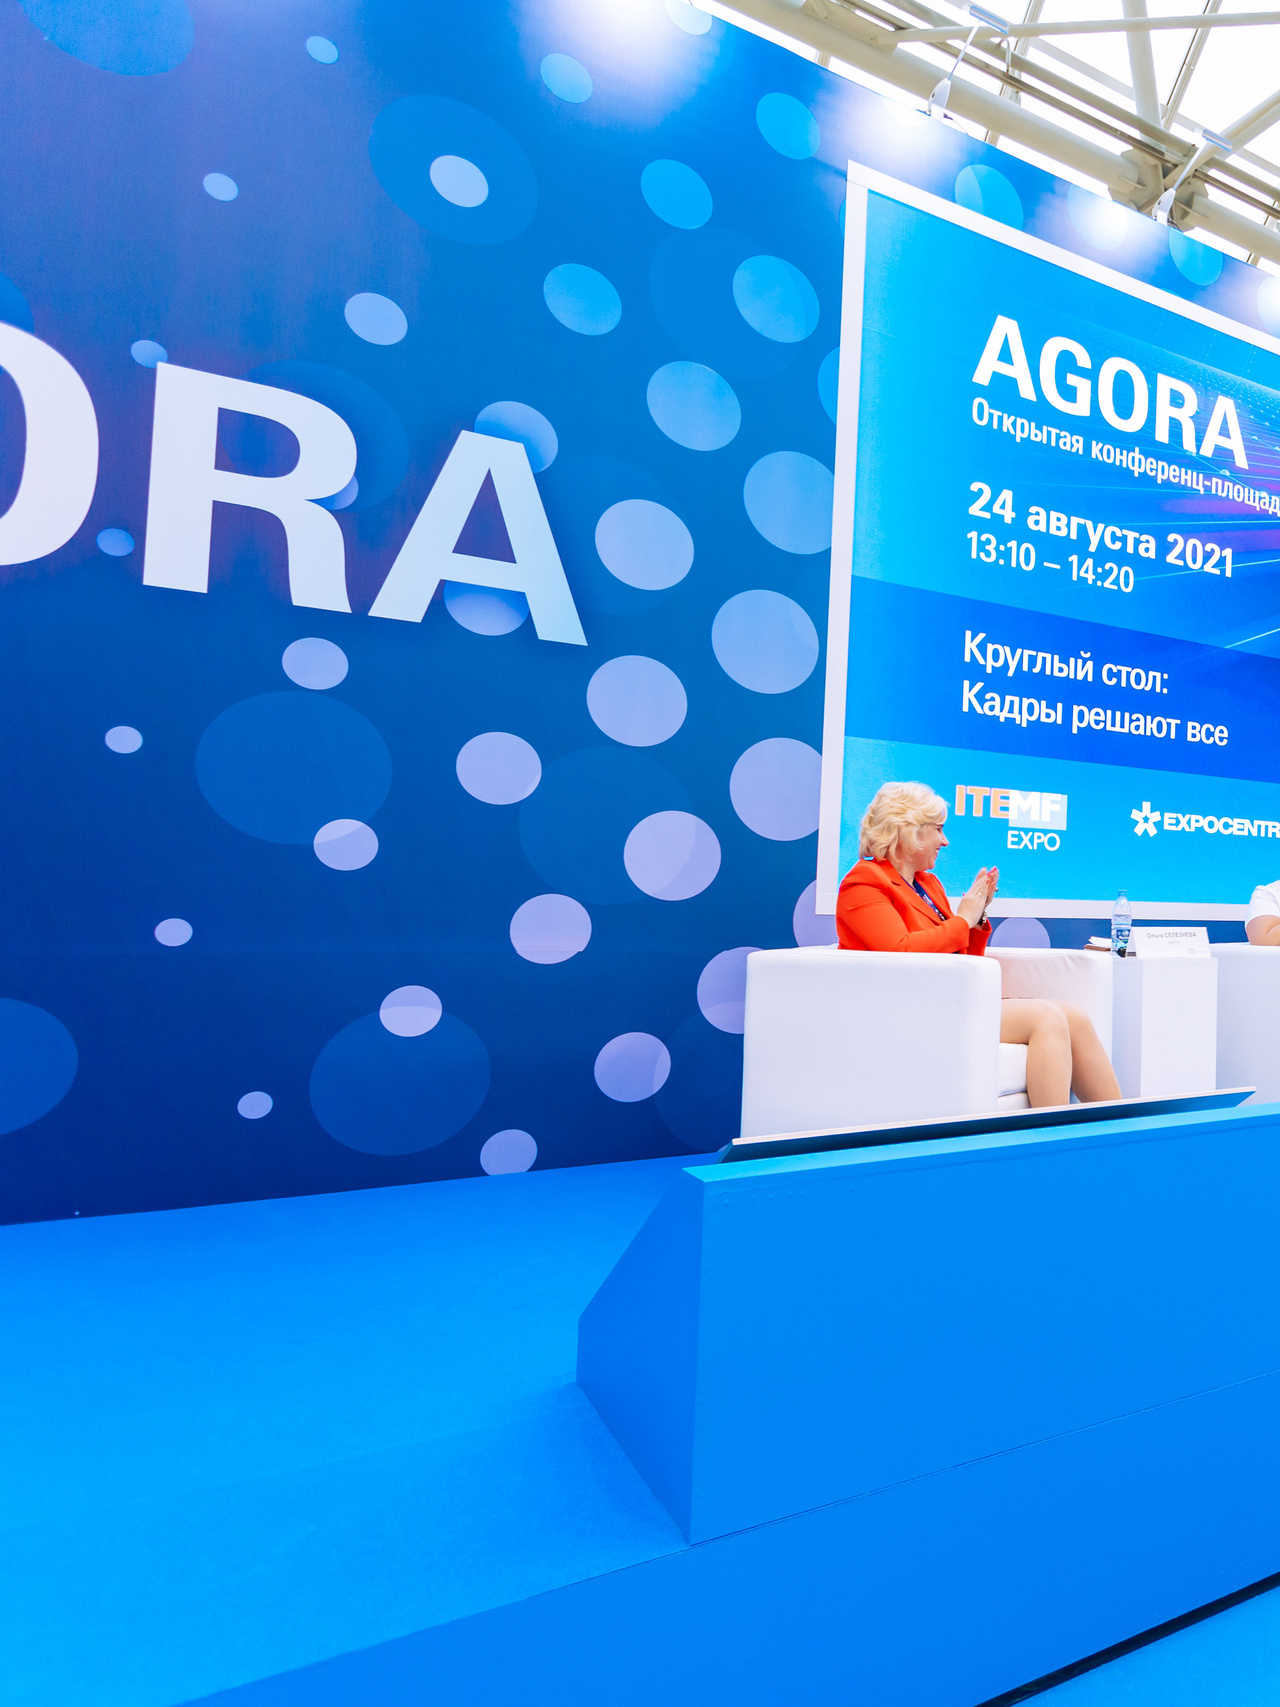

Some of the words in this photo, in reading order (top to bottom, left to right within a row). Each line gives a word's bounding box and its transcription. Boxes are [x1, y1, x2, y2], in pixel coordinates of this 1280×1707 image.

[972, 314, 1249, 470] AGORA
[972, 397, 1083, 455] Открытая
[966, 530, 1036, 572] 13:10
[1068, 554, 1135, 593] 14:20
[968, 481, 1016, 524] 24
[1026, 505, 1156, 560] августа
[1165, 533, 1233, 578] 2021
[963, 630, 1094, 683] Круглый
[1101, 662, 1169, 694] стол:
[962, 680, 1063, 728] Кадры
[1072, 704, 1181, 740] решают
[1186, 721, 1229, 746] все
[1006, 830, 1061, 851] EXPO
